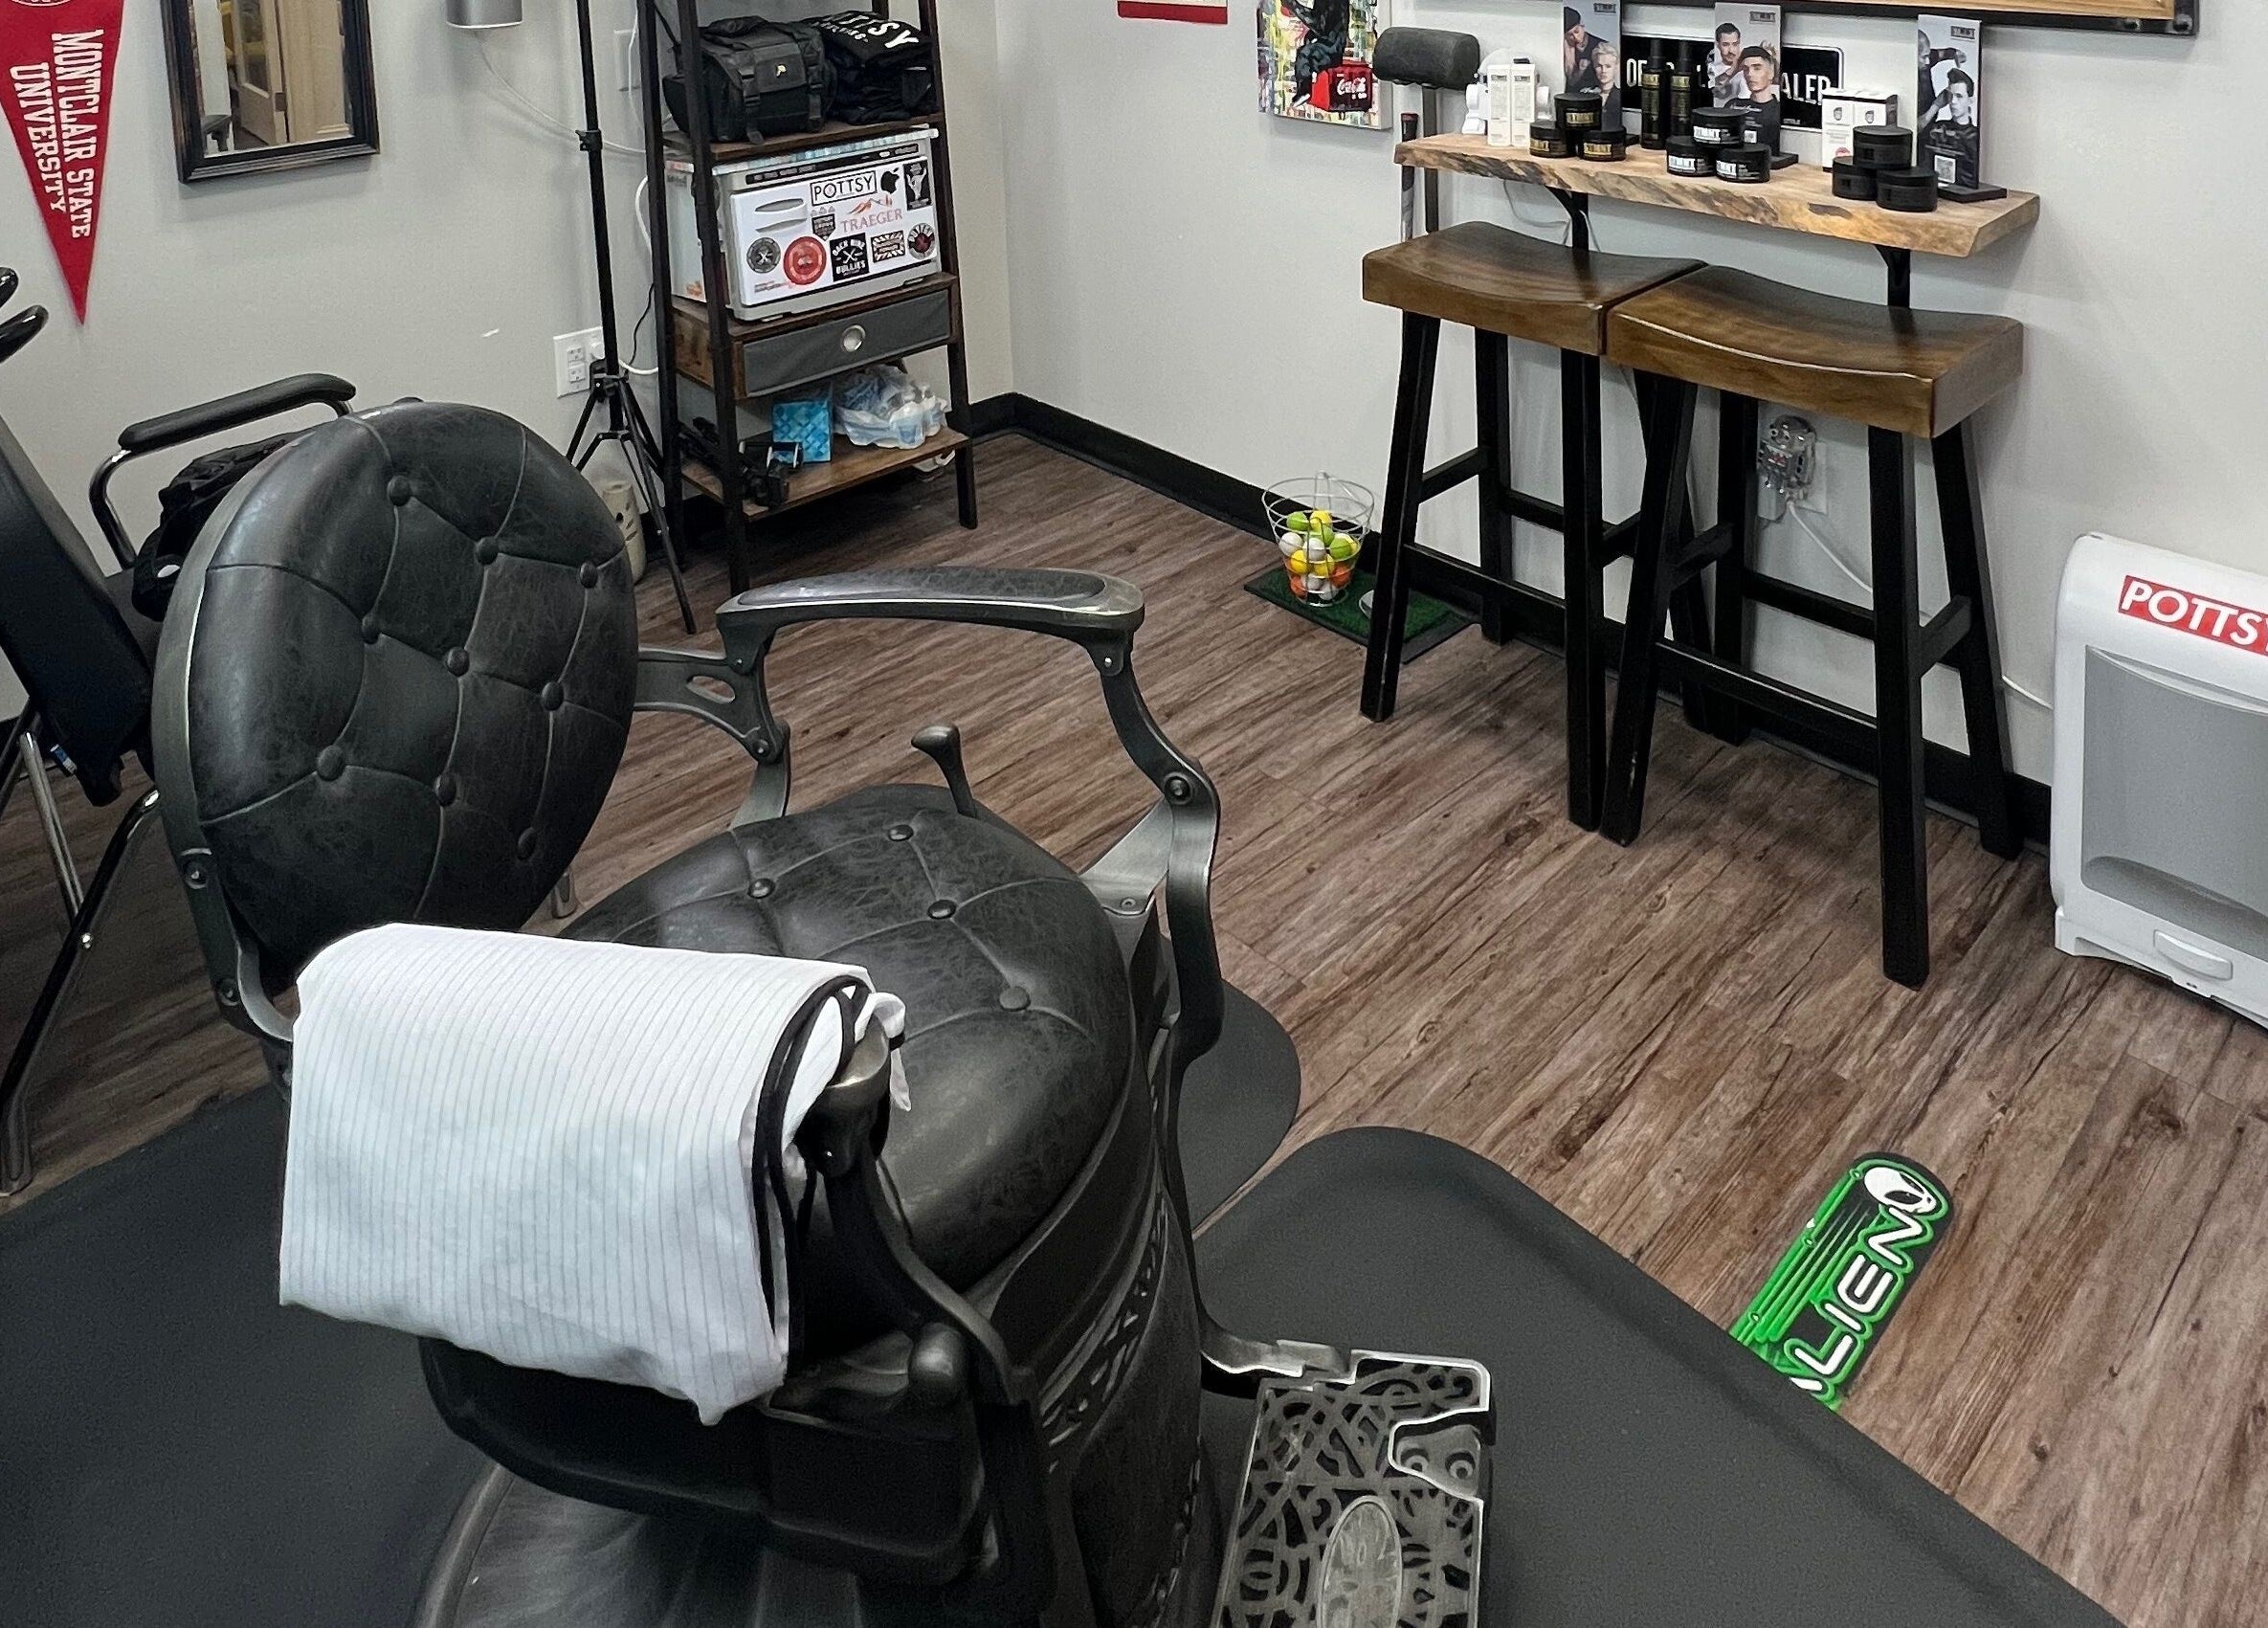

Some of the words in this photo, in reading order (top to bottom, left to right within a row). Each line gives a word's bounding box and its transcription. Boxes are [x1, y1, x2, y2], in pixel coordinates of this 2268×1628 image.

[52, 29, 104, 163] MONTCLAIR
[9, 61, 67, 213] UNIVERSITY
[66, 167, 95, 238] STATE
[813, 175, 874, 202] POTTSY
[840, 209, 903, 234] TRAEGER
[2121, 580, 2268, 652] POTTS
